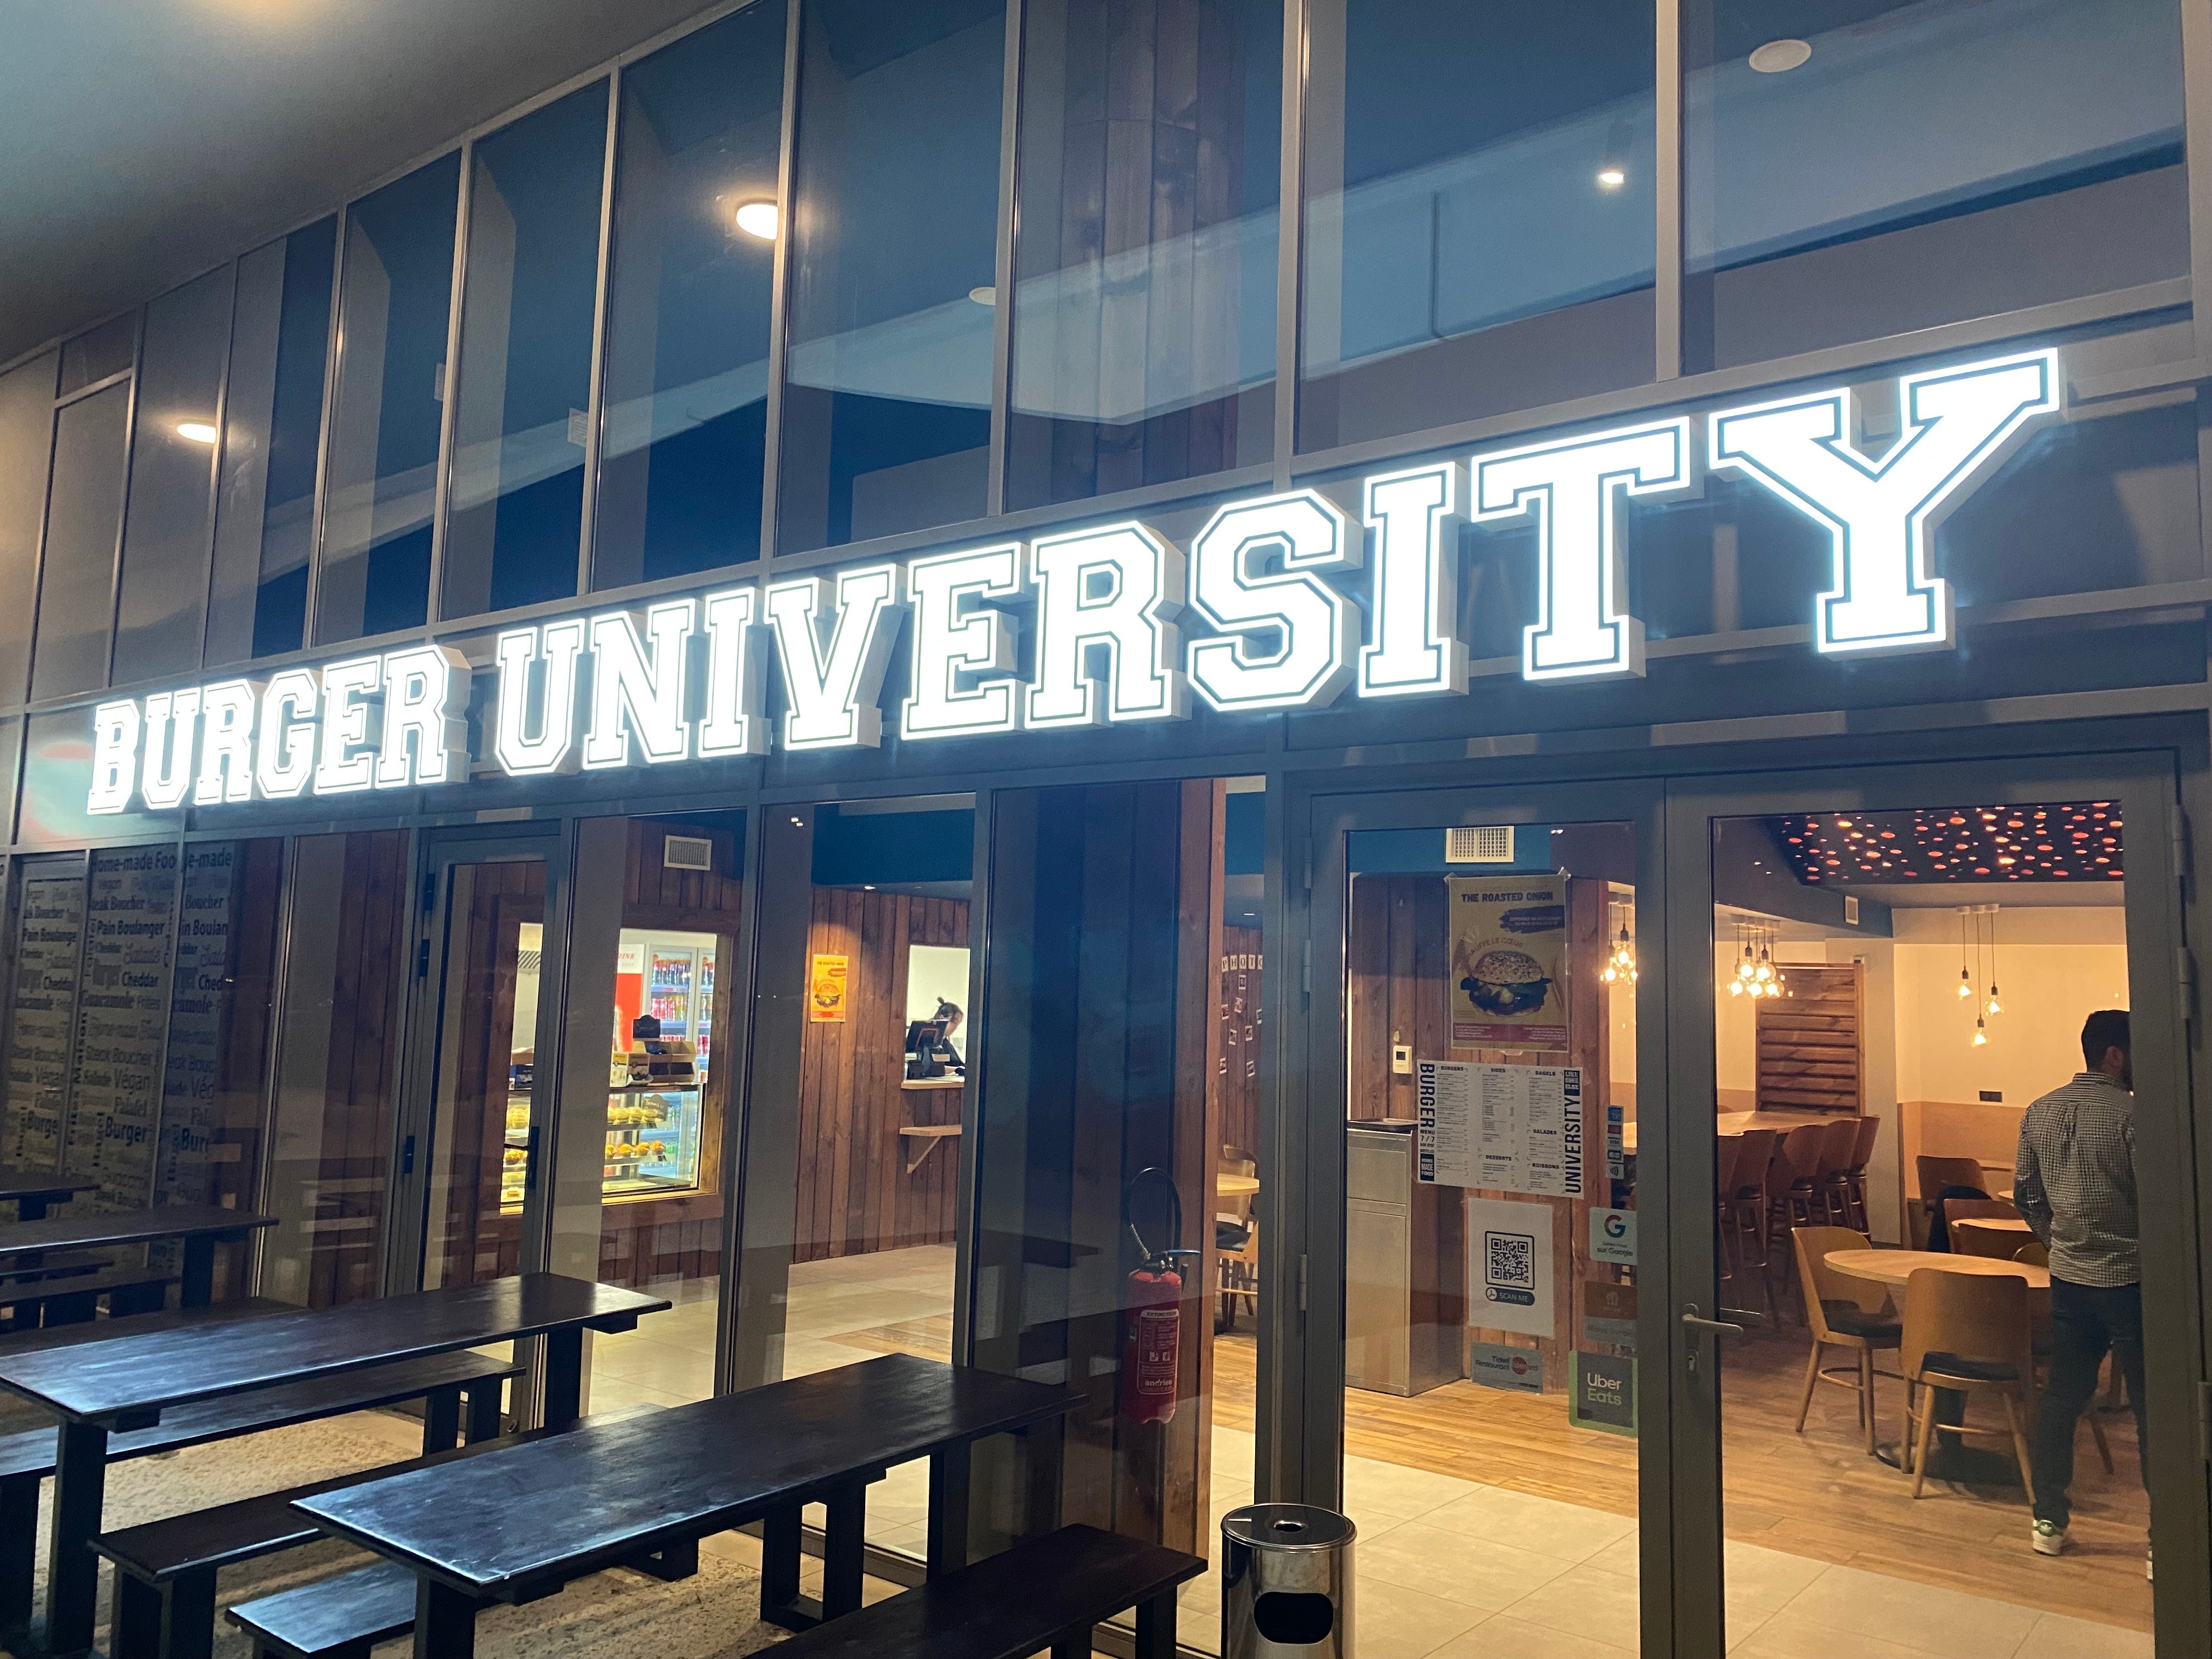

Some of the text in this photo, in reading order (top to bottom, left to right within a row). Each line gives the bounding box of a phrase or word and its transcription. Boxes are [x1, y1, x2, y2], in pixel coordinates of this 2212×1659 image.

[87, 347, 2059, 815] BURGER UNIVERSITY
[155, 851, 177, 870] Foo
[183, 849, 233, 868] e-made
[110, 894, 145, 911] Boucher
[185, 894, 224, 910] Boucher
[1462, 891, 1554, 903] THE ROASTED ONION
[98, 919, 165, 939] Pain Boulanger
[122, 971, 159, 988] Cheddar
[173, 994, 213, 1014] camole
[1420, 1063, 1435, 1127] BURGER
[105, 1115, 148, 1147] Burger
[1564, 1097, 1581, 1193] UNIVERSITY
[1609, 1248, 1633, 1257] Google
[1499, 1293, 1517, 1301] SCAN
[1587, 1373, 1622, 1390] Uber
[1587, 1387, 1622, 1406] Eats
